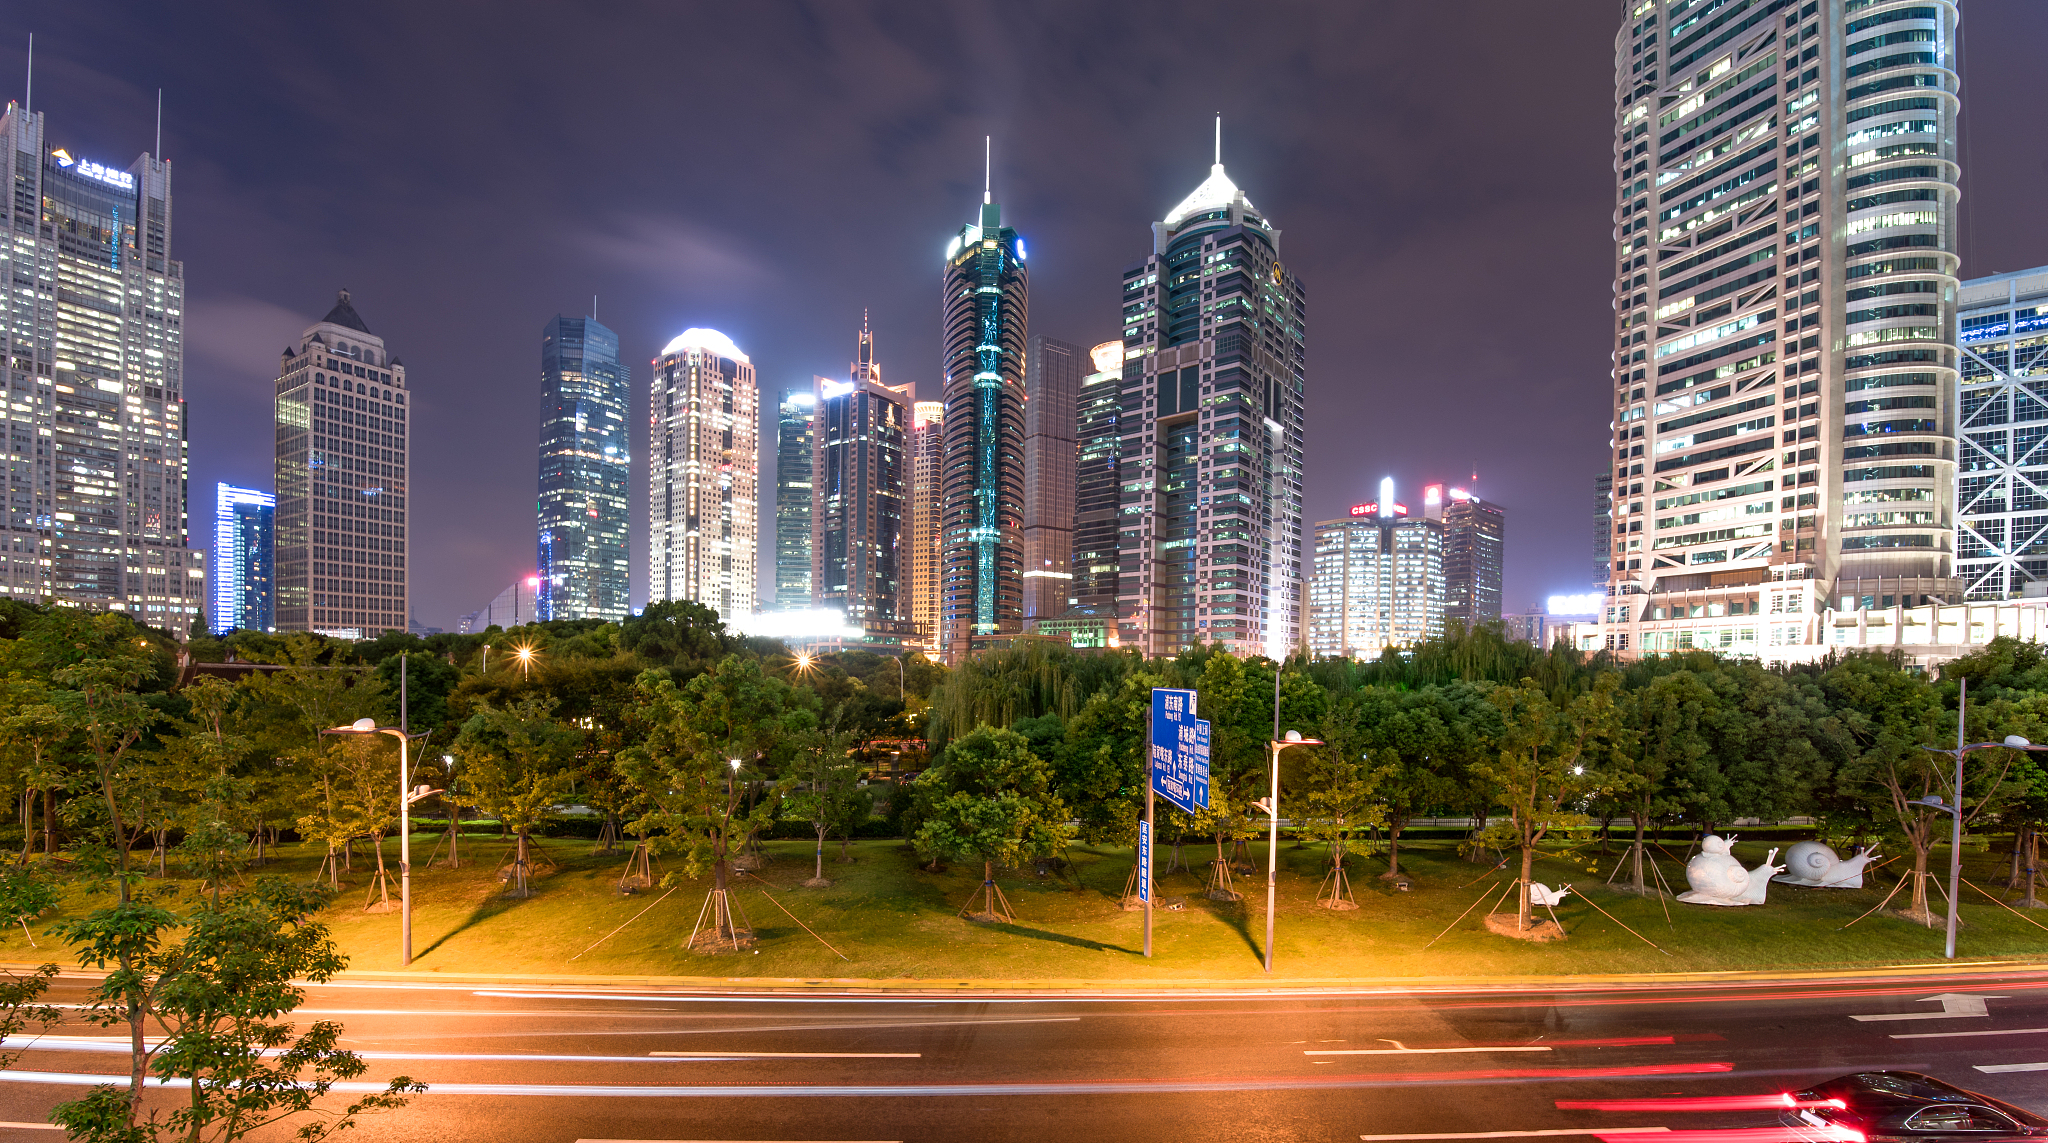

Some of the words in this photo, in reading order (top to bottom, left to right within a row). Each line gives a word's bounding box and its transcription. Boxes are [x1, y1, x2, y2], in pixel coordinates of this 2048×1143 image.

[1351, 503, 1378, 515] CSSC
[1165, 694, 1183, 712] 浦东南路
[1178, 724, 1196, 745] 浦城路
[1153, 743, 1173, 765] 陆家嘴东路
